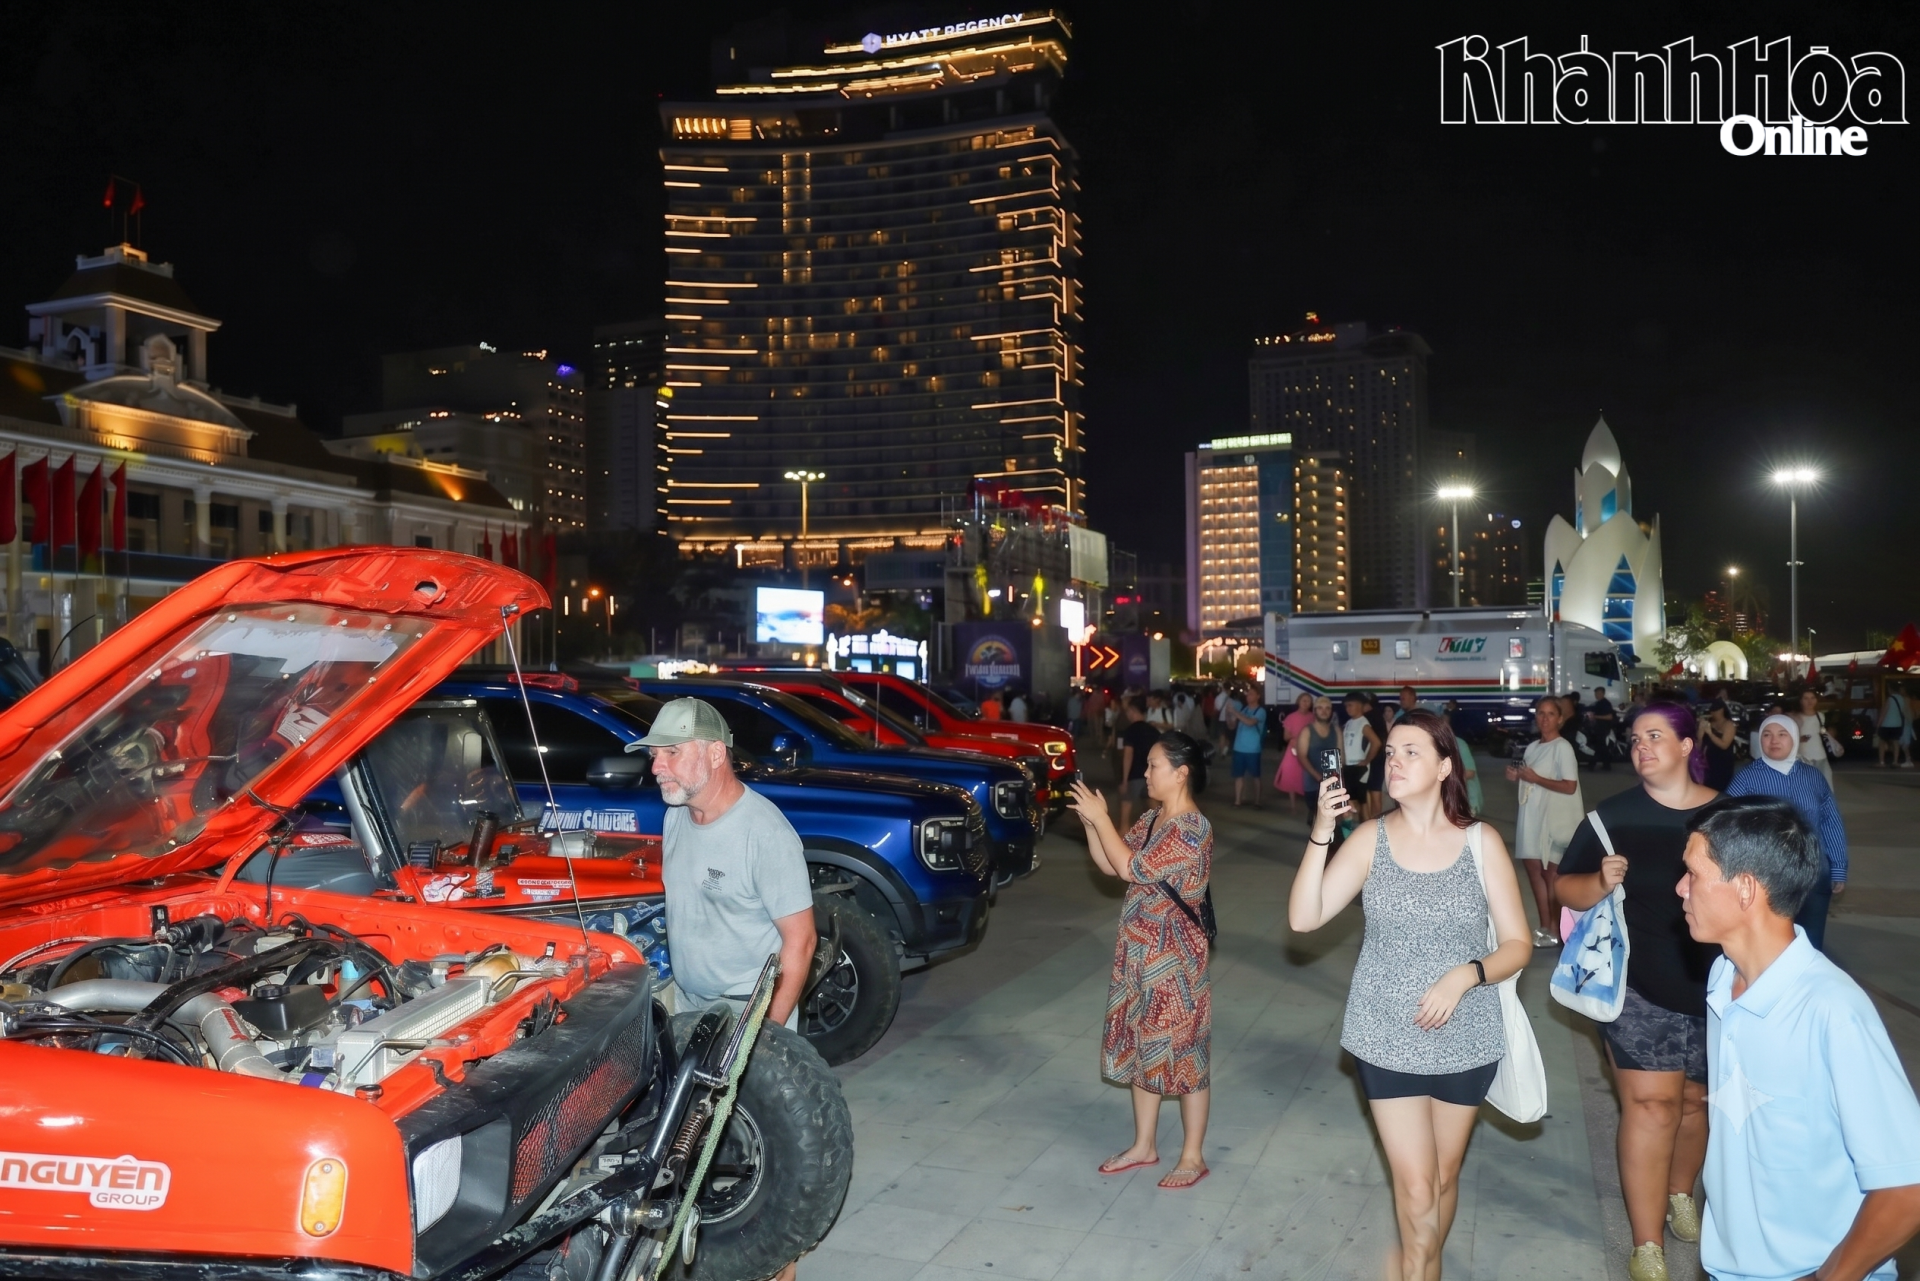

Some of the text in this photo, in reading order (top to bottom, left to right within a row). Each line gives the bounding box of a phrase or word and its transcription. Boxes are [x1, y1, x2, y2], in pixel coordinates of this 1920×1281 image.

[886, 13, 1023, 45] HYATT REGENCY
[96, 1192, 160, 1206] GROUP
